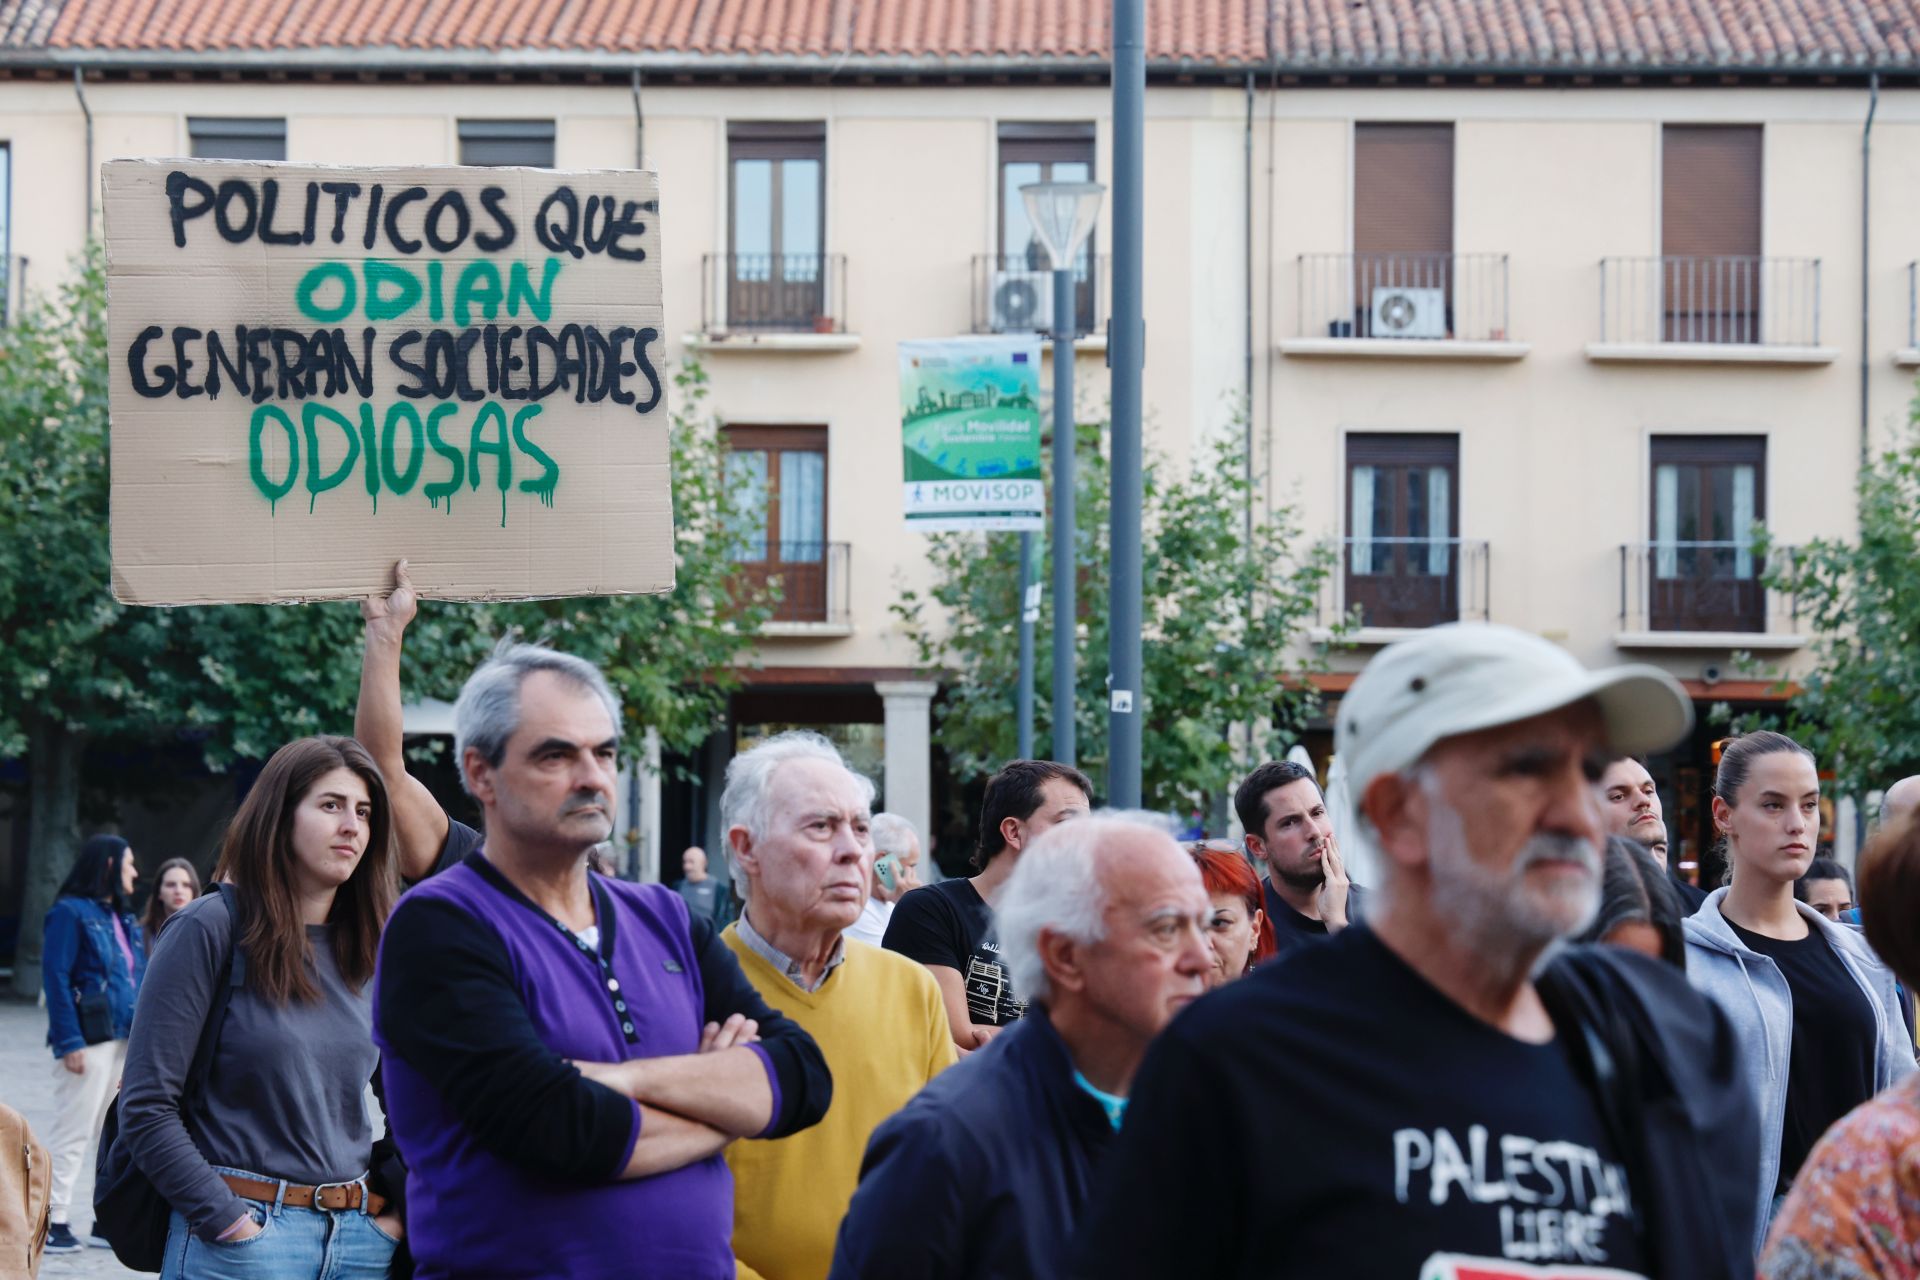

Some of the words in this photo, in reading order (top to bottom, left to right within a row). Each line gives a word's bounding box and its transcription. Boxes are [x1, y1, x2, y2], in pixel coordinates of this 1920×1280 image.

[166, 170, 516, 254] POLITICOS
[535, 186, 658, 261] QUE
[296, 258, 561, 326] ODIAN
[127, 325, 377, 403] GENERAN
[388, 323, 661, 413] SOCIEDADES
[249, 401, 560, 512] ODIOSAS
